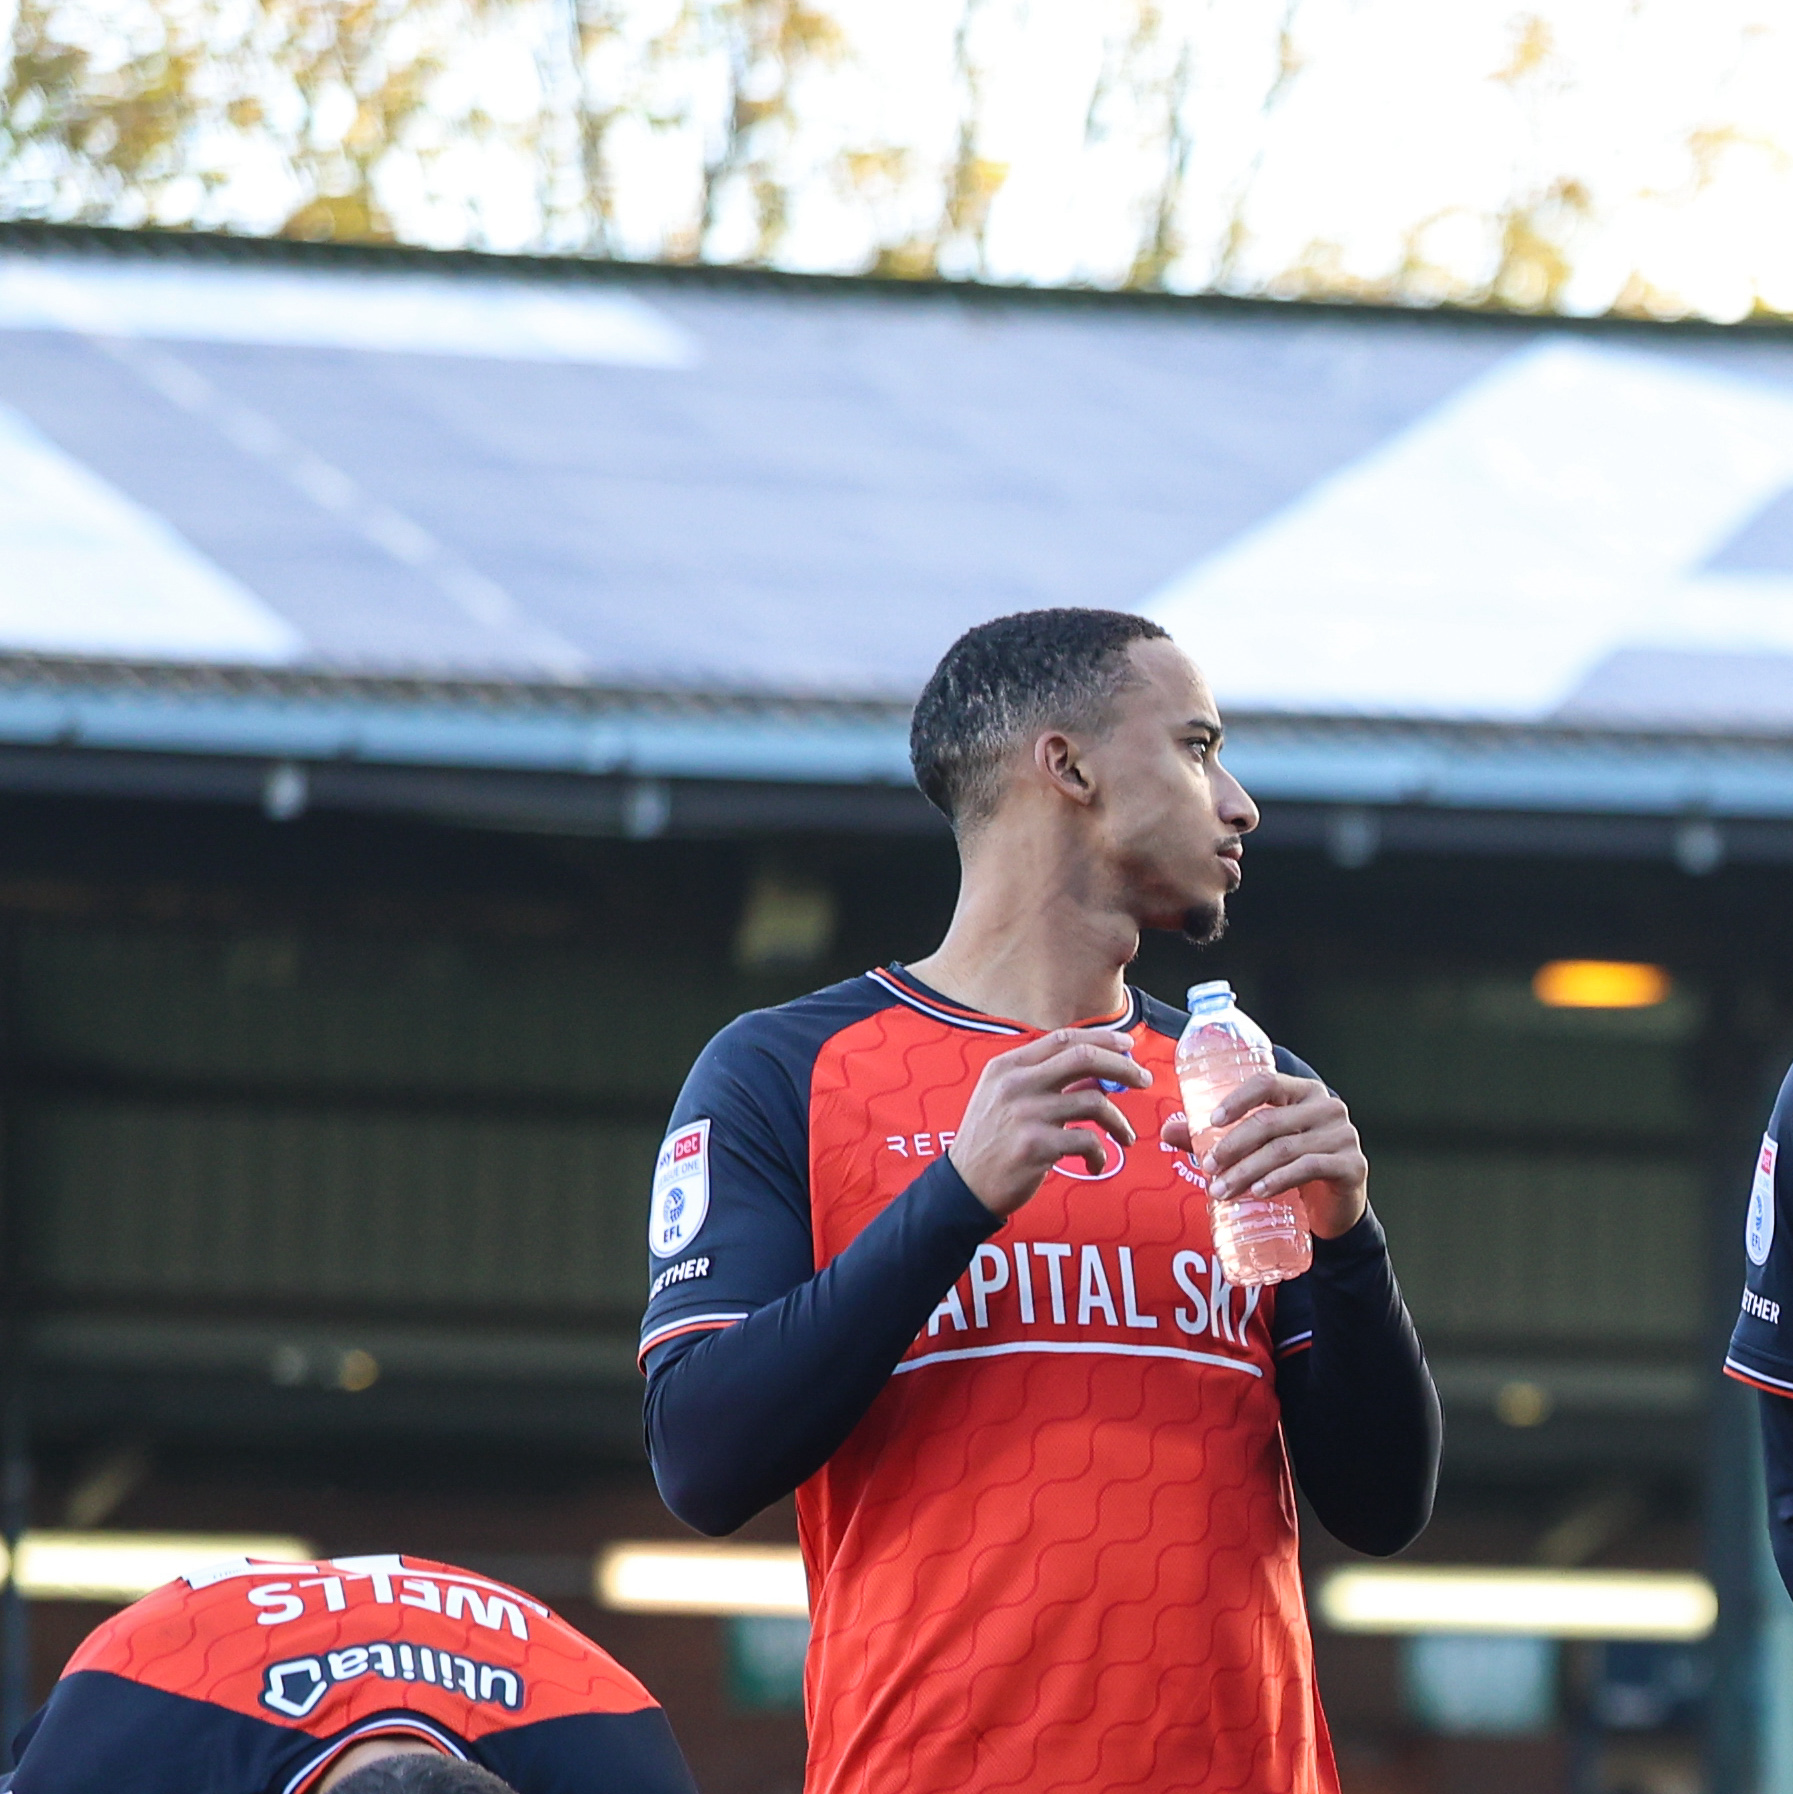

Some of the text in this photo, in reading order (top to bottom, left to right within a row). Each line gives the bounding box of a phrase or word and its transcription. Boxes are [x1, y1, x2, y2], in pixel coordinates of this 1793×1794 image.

[675, 1134, 698, 1158] bet
[886, 1131, 955, 1158] REF
[1172, 1160, 1206, 1189] FOOTB
[663, 1225, 682, 1244] EFL
[649, 1256, 710, 1302] ETHER
[908, 1242, 1157, 1342] APITAL
[1741, 1286, 1780, 1326] ETHER
[247, 1573, 530, 1641] WELLS
[328, 1643, 518, 1708] utilita
